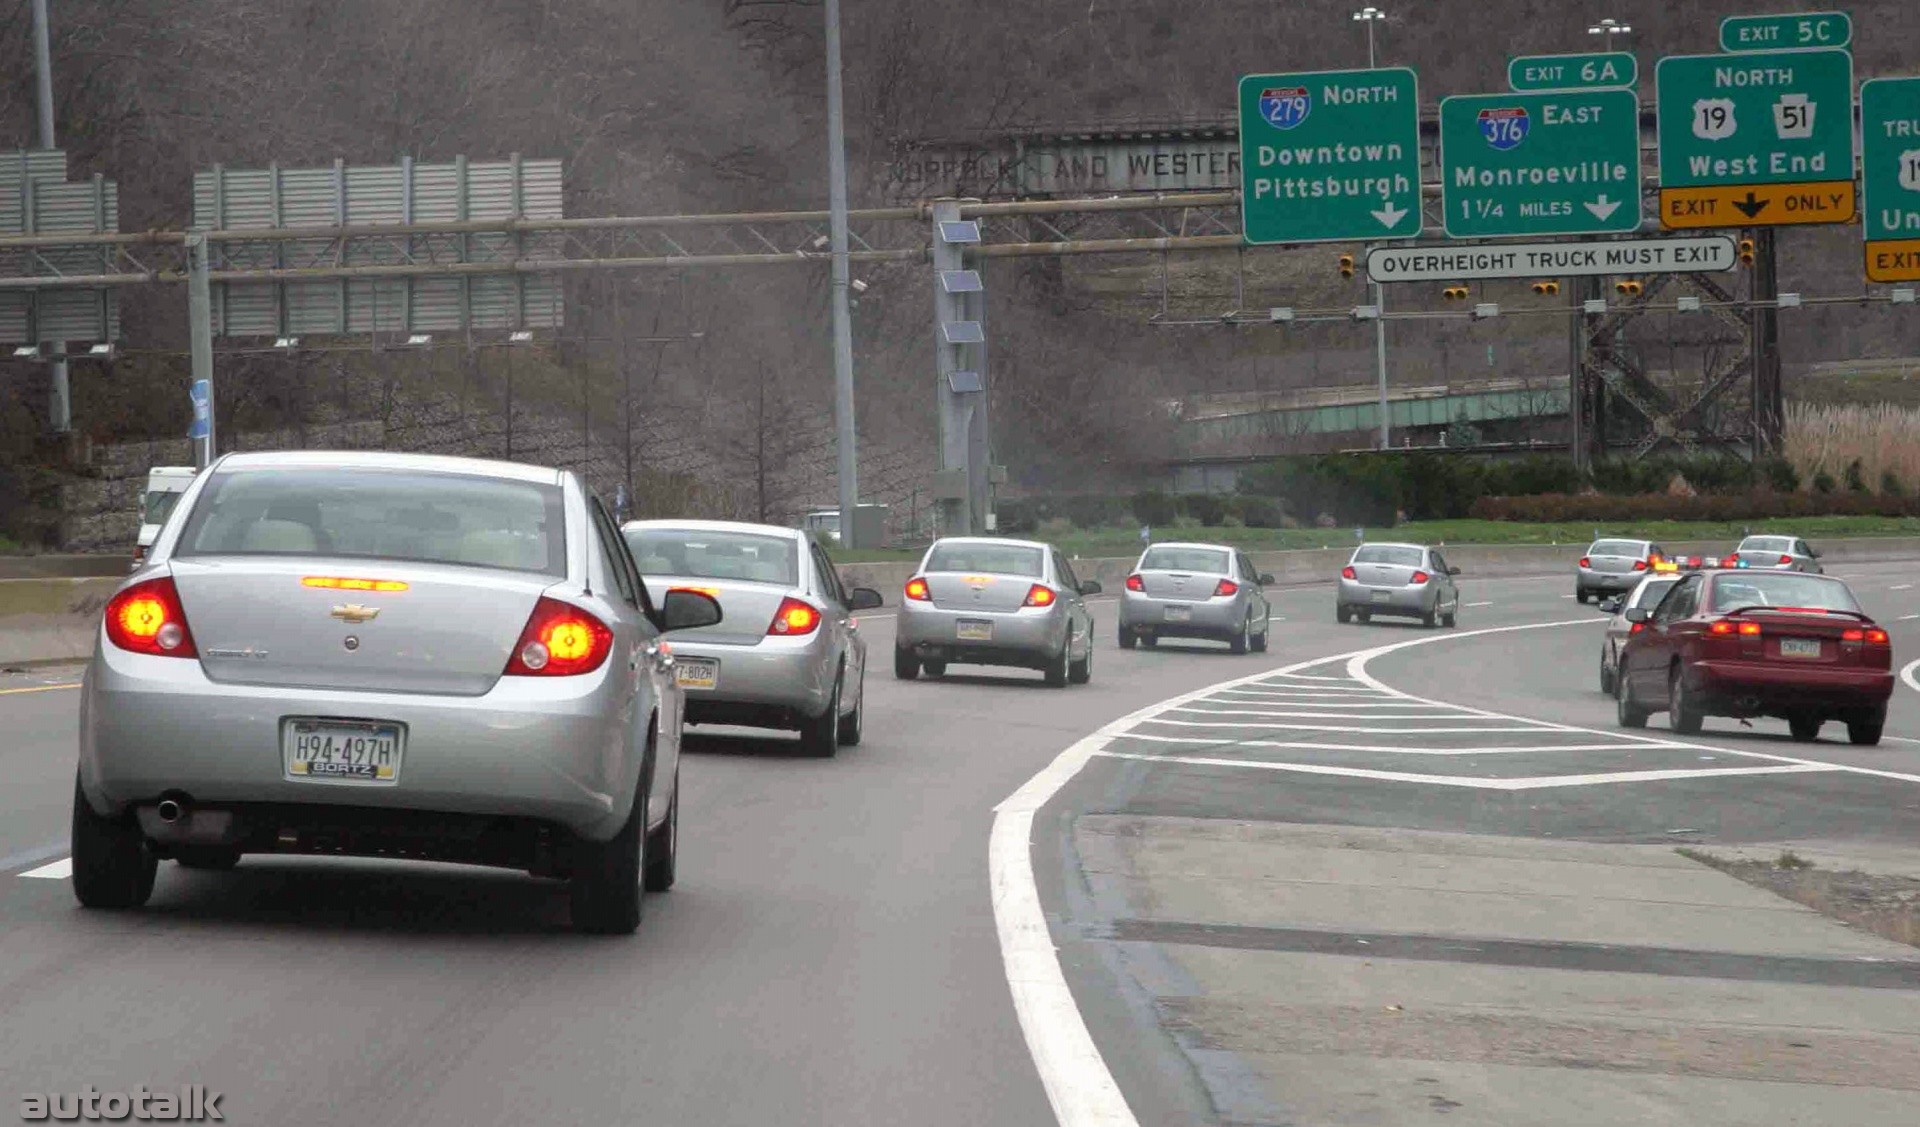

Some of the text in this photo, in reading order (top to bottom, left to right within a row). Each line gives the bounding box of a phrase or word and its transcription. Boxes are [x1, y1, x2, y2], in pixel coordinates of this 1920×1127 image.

[1738, 21, 1831, 42] EXIT 5C
[1525, 61, 1618, 82] EXIT 6A
[1715, 67, 1793, 88] NORTH
[1323, 85, 1397, 105] NORTH
[1270, 97, 1306, 121] 279
[1542, 105, 1602, 125] EAST
[1701, 107, 1726, 130] 19
[1782, 106, 1807, 129] 51
[1486, 118, 1522, 142] 376
[1258, 143, 1402, 167] Downtown
[1689, 152, 1826, 177] West End
[1054, 155, 1107, 179] AND
[1455, 162, 1627, 188] Monroeville
[1909, 158, 1920, 182] 1
[1254, 173, 1409, 201] Pittsburgh
[1519, 201, 1573, 217] MILES
[1670, 194, 1844, 217] EXIT ONLY
[1383, 245, 1722, 273] OVERHEIGHT TRUCK MUST EXIT
[296, 735, 391, 766] H94-497H
[313, 762, 371, 774] BORTZ
